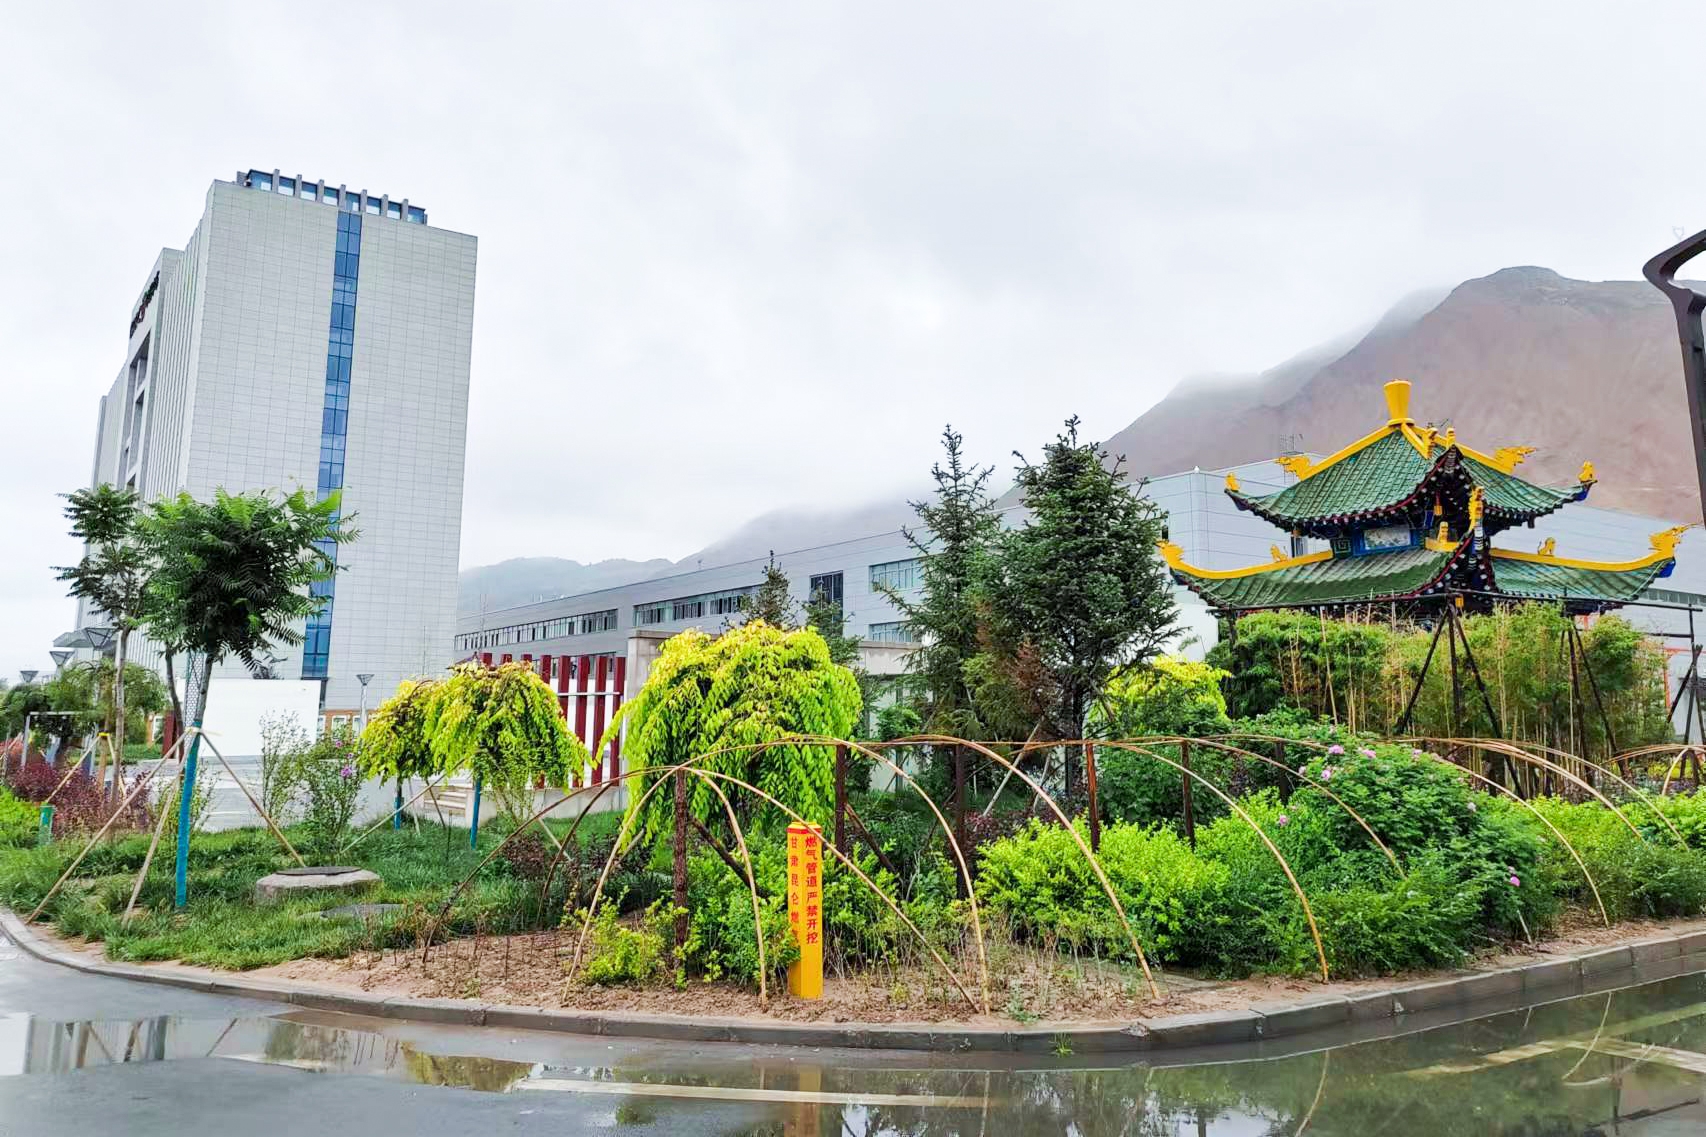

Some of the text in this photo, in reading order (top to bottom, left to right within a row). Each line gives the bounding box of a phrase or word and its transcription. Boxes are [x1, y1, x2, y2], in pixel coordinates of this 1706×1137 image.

[806, 835, 818, 944] 燃气管道严禁开挖
